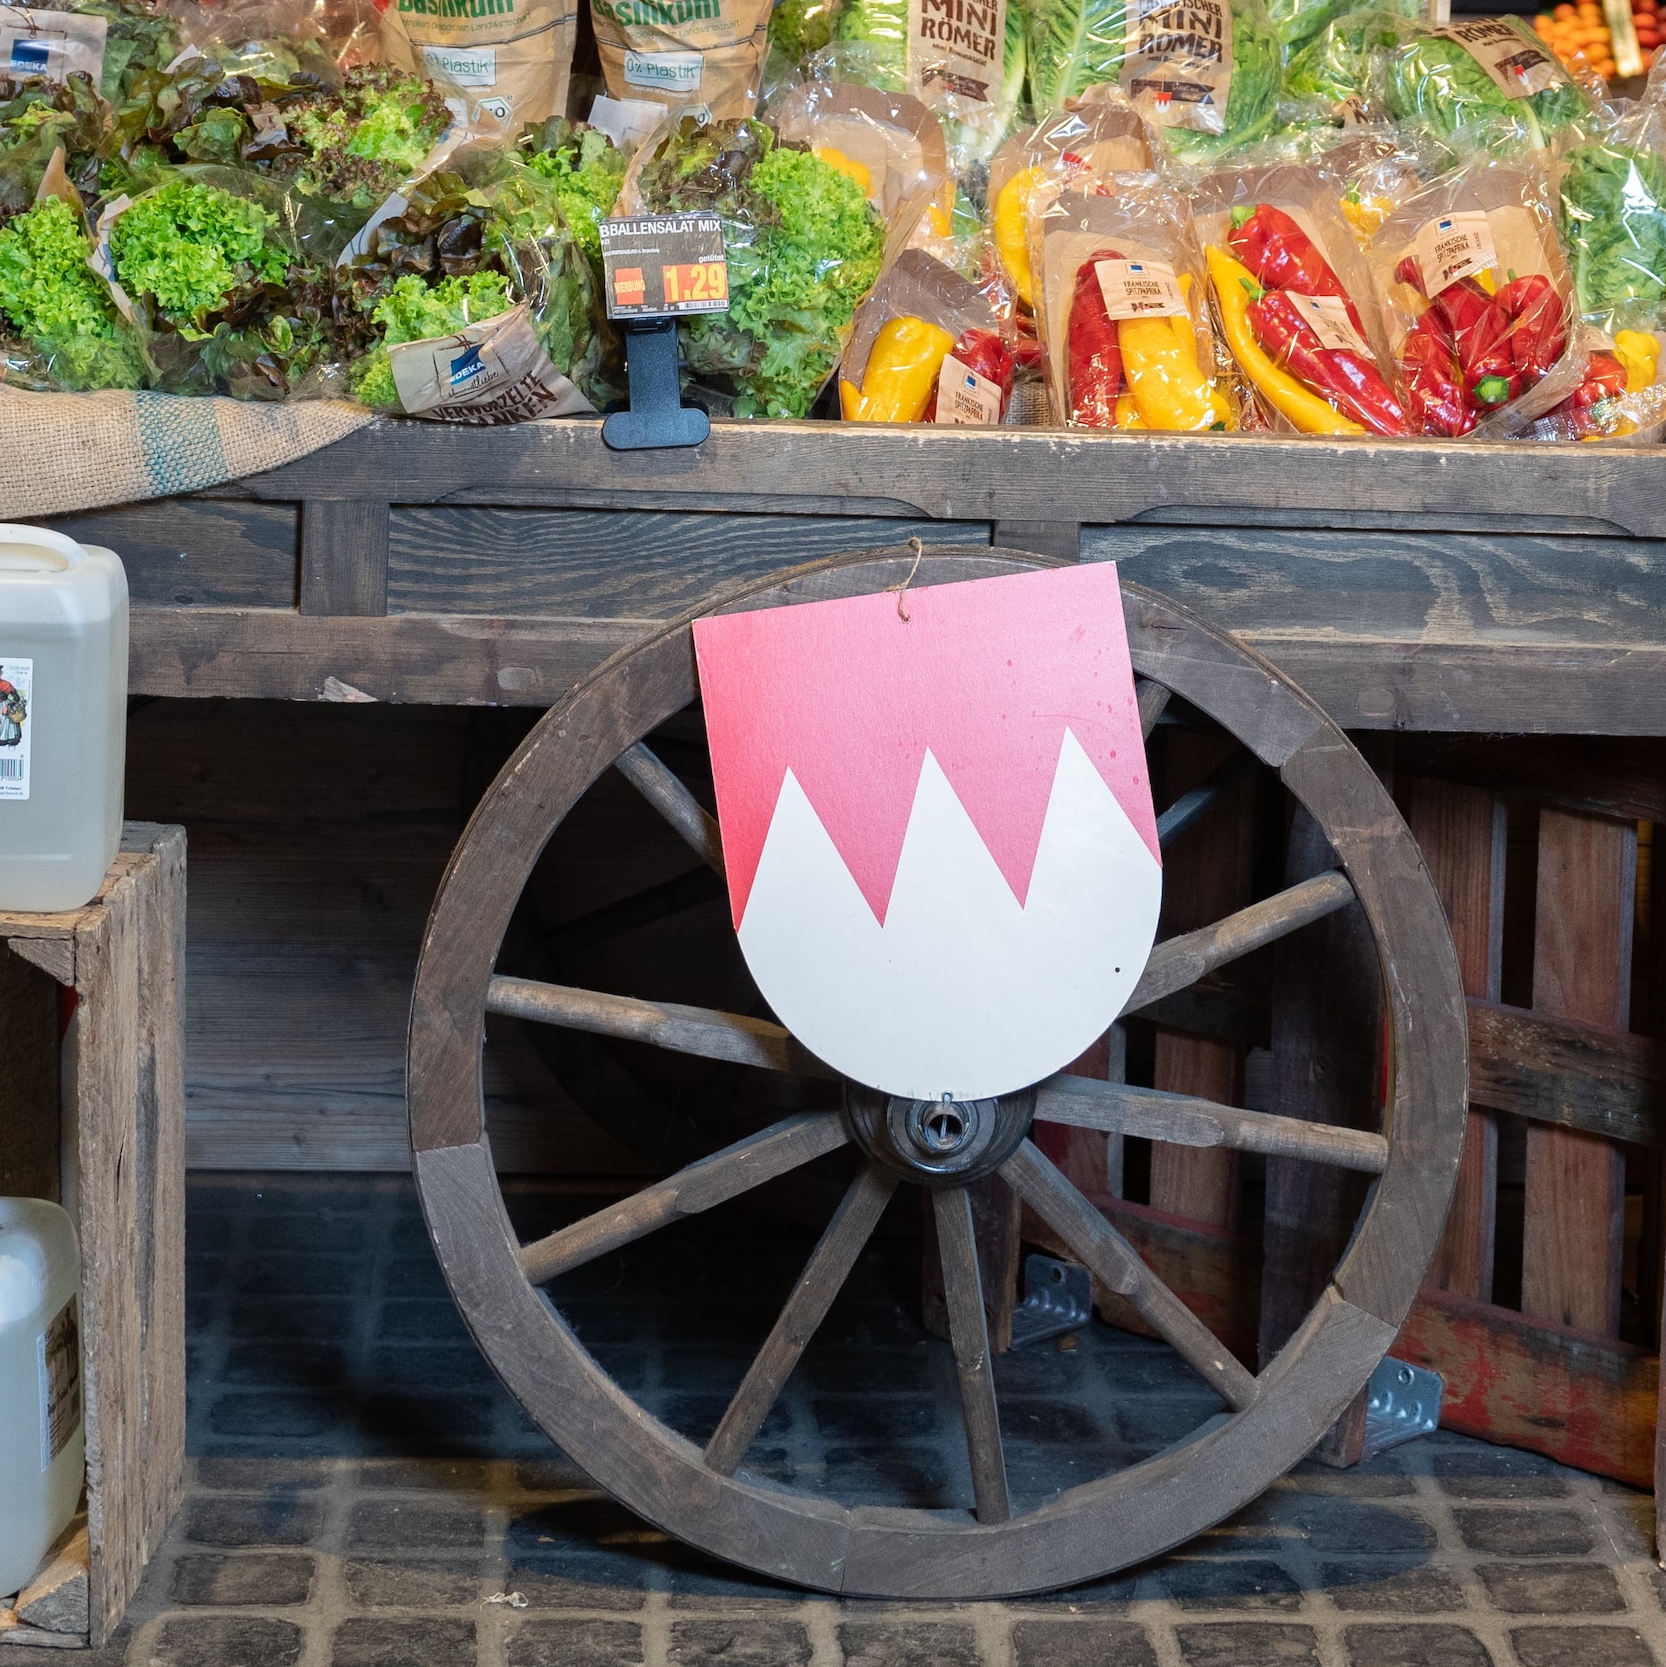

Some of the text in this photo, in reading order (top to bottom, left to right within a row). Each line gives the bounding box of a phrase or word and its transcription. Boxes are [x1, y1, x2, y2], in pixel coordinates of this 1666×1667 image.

[921, 16, 995, 61] RÖMER
[442, 57, 488, 74] Plastik
[627, 58, 696, 78] 0% Plastik
[698, 220, 721, 232] MIX
[666, 264, 726, 301] 1.29
